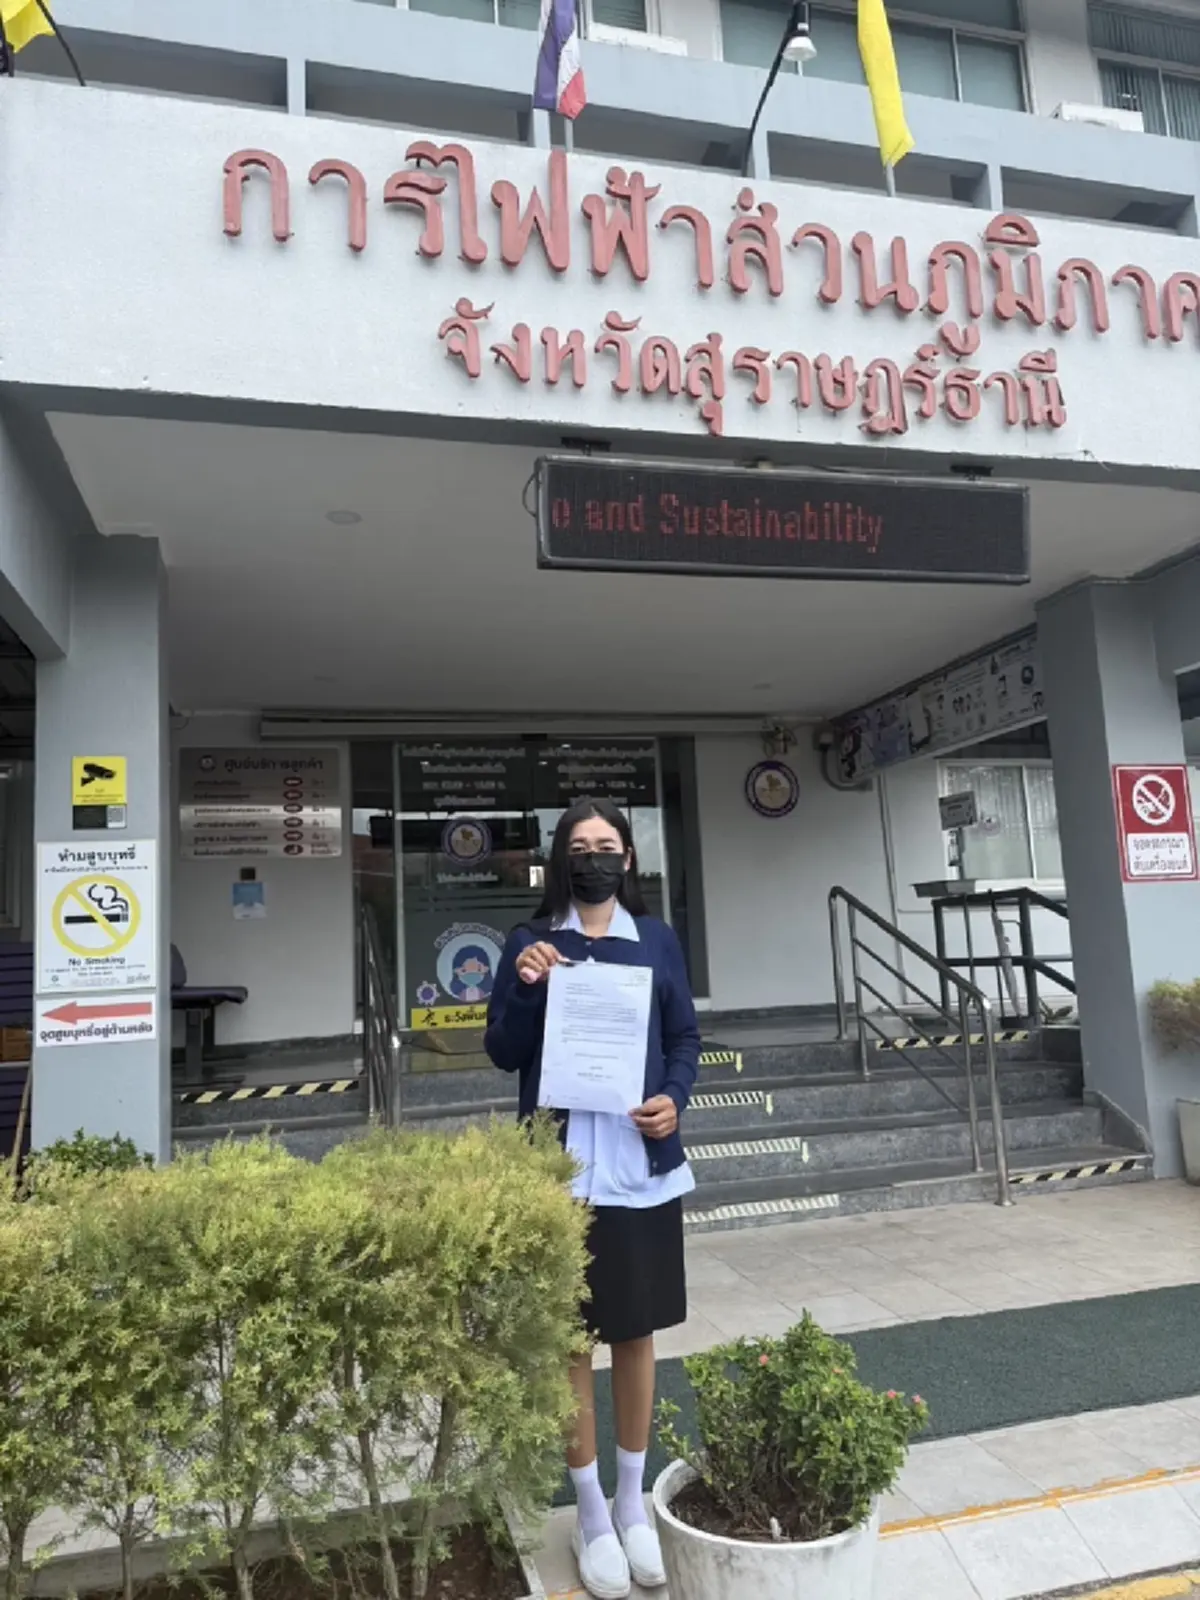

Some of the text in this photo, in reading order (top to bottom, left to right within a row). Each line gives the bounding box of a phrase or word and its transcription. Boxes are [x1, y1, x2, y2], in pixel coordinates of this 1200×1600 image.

[223, 141, 1200, 355] การไฟฟ้าส่วนภูมิภาค
[438, 297, 1067, 437] จังหวัดสุราษฎร์ธานี
[585, 494, 646, 532] and
[659, 493, 882, 553] Sustainability
[68, 956, 126, 967] No Smoking
